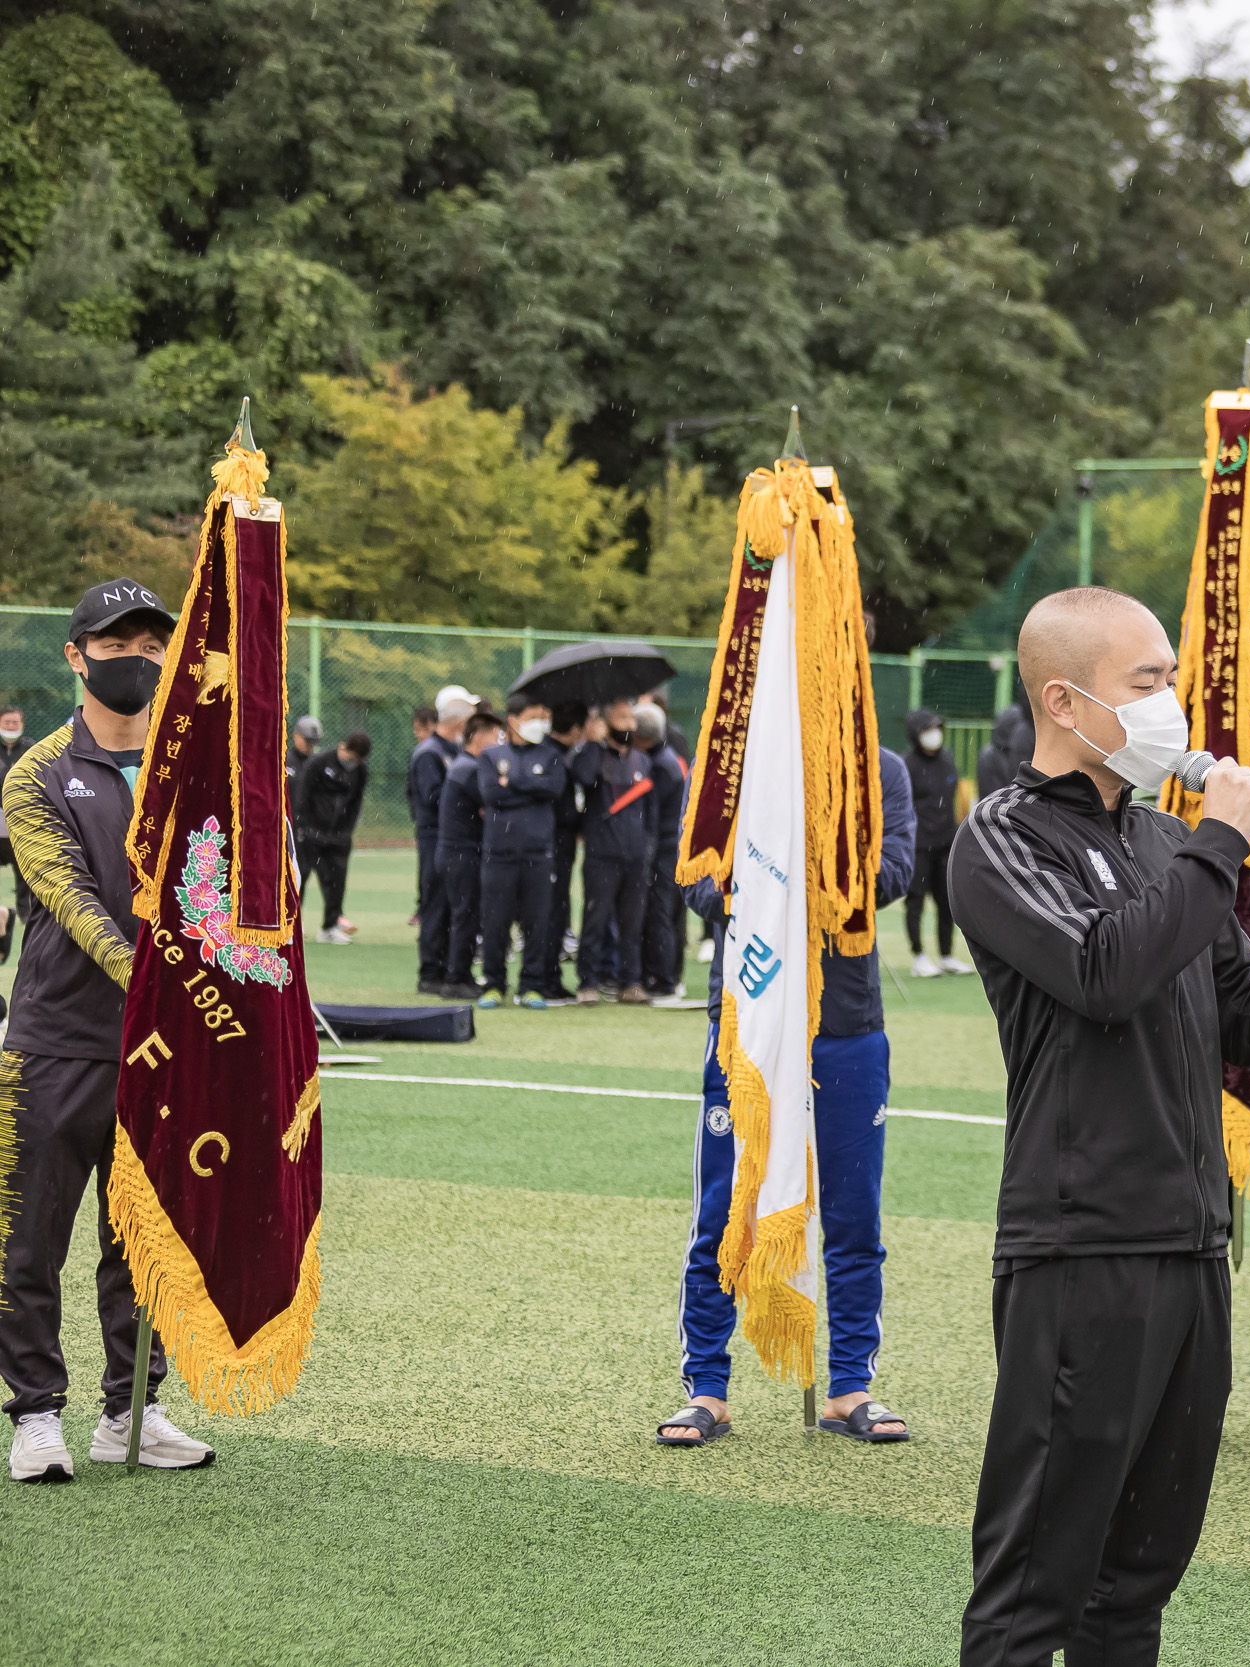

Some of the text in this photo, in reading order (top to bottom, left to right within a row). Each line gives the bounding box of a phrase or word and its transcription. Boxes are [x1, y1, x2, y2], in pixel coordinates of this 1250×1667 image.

[102, 586, 156, 607] NYC
[155, 714, 192, 785] 장년부
[137, 815, 156, 861] 우승
[183, 968, 247, 1043] 1987
